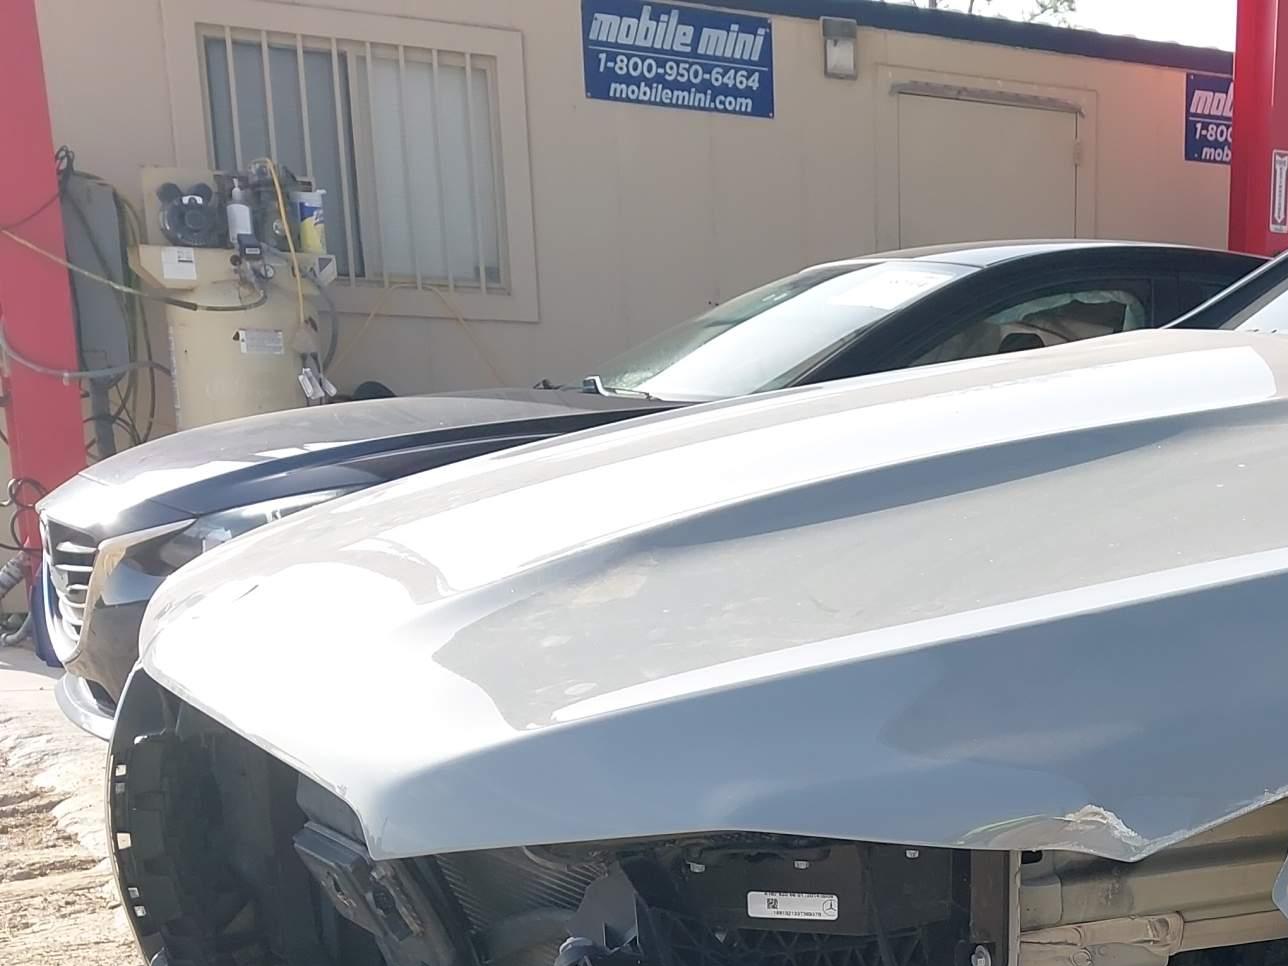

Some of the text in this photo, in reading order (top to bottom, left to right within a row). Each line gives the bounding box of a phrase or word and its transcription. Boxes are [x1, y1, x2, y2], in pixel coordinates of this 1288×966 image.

[589, 5, 767, 61] mobile mini
[597, 53, 760, 91] 1-800-950-6464
[609, 82, 752, 112] mobilemini.com
